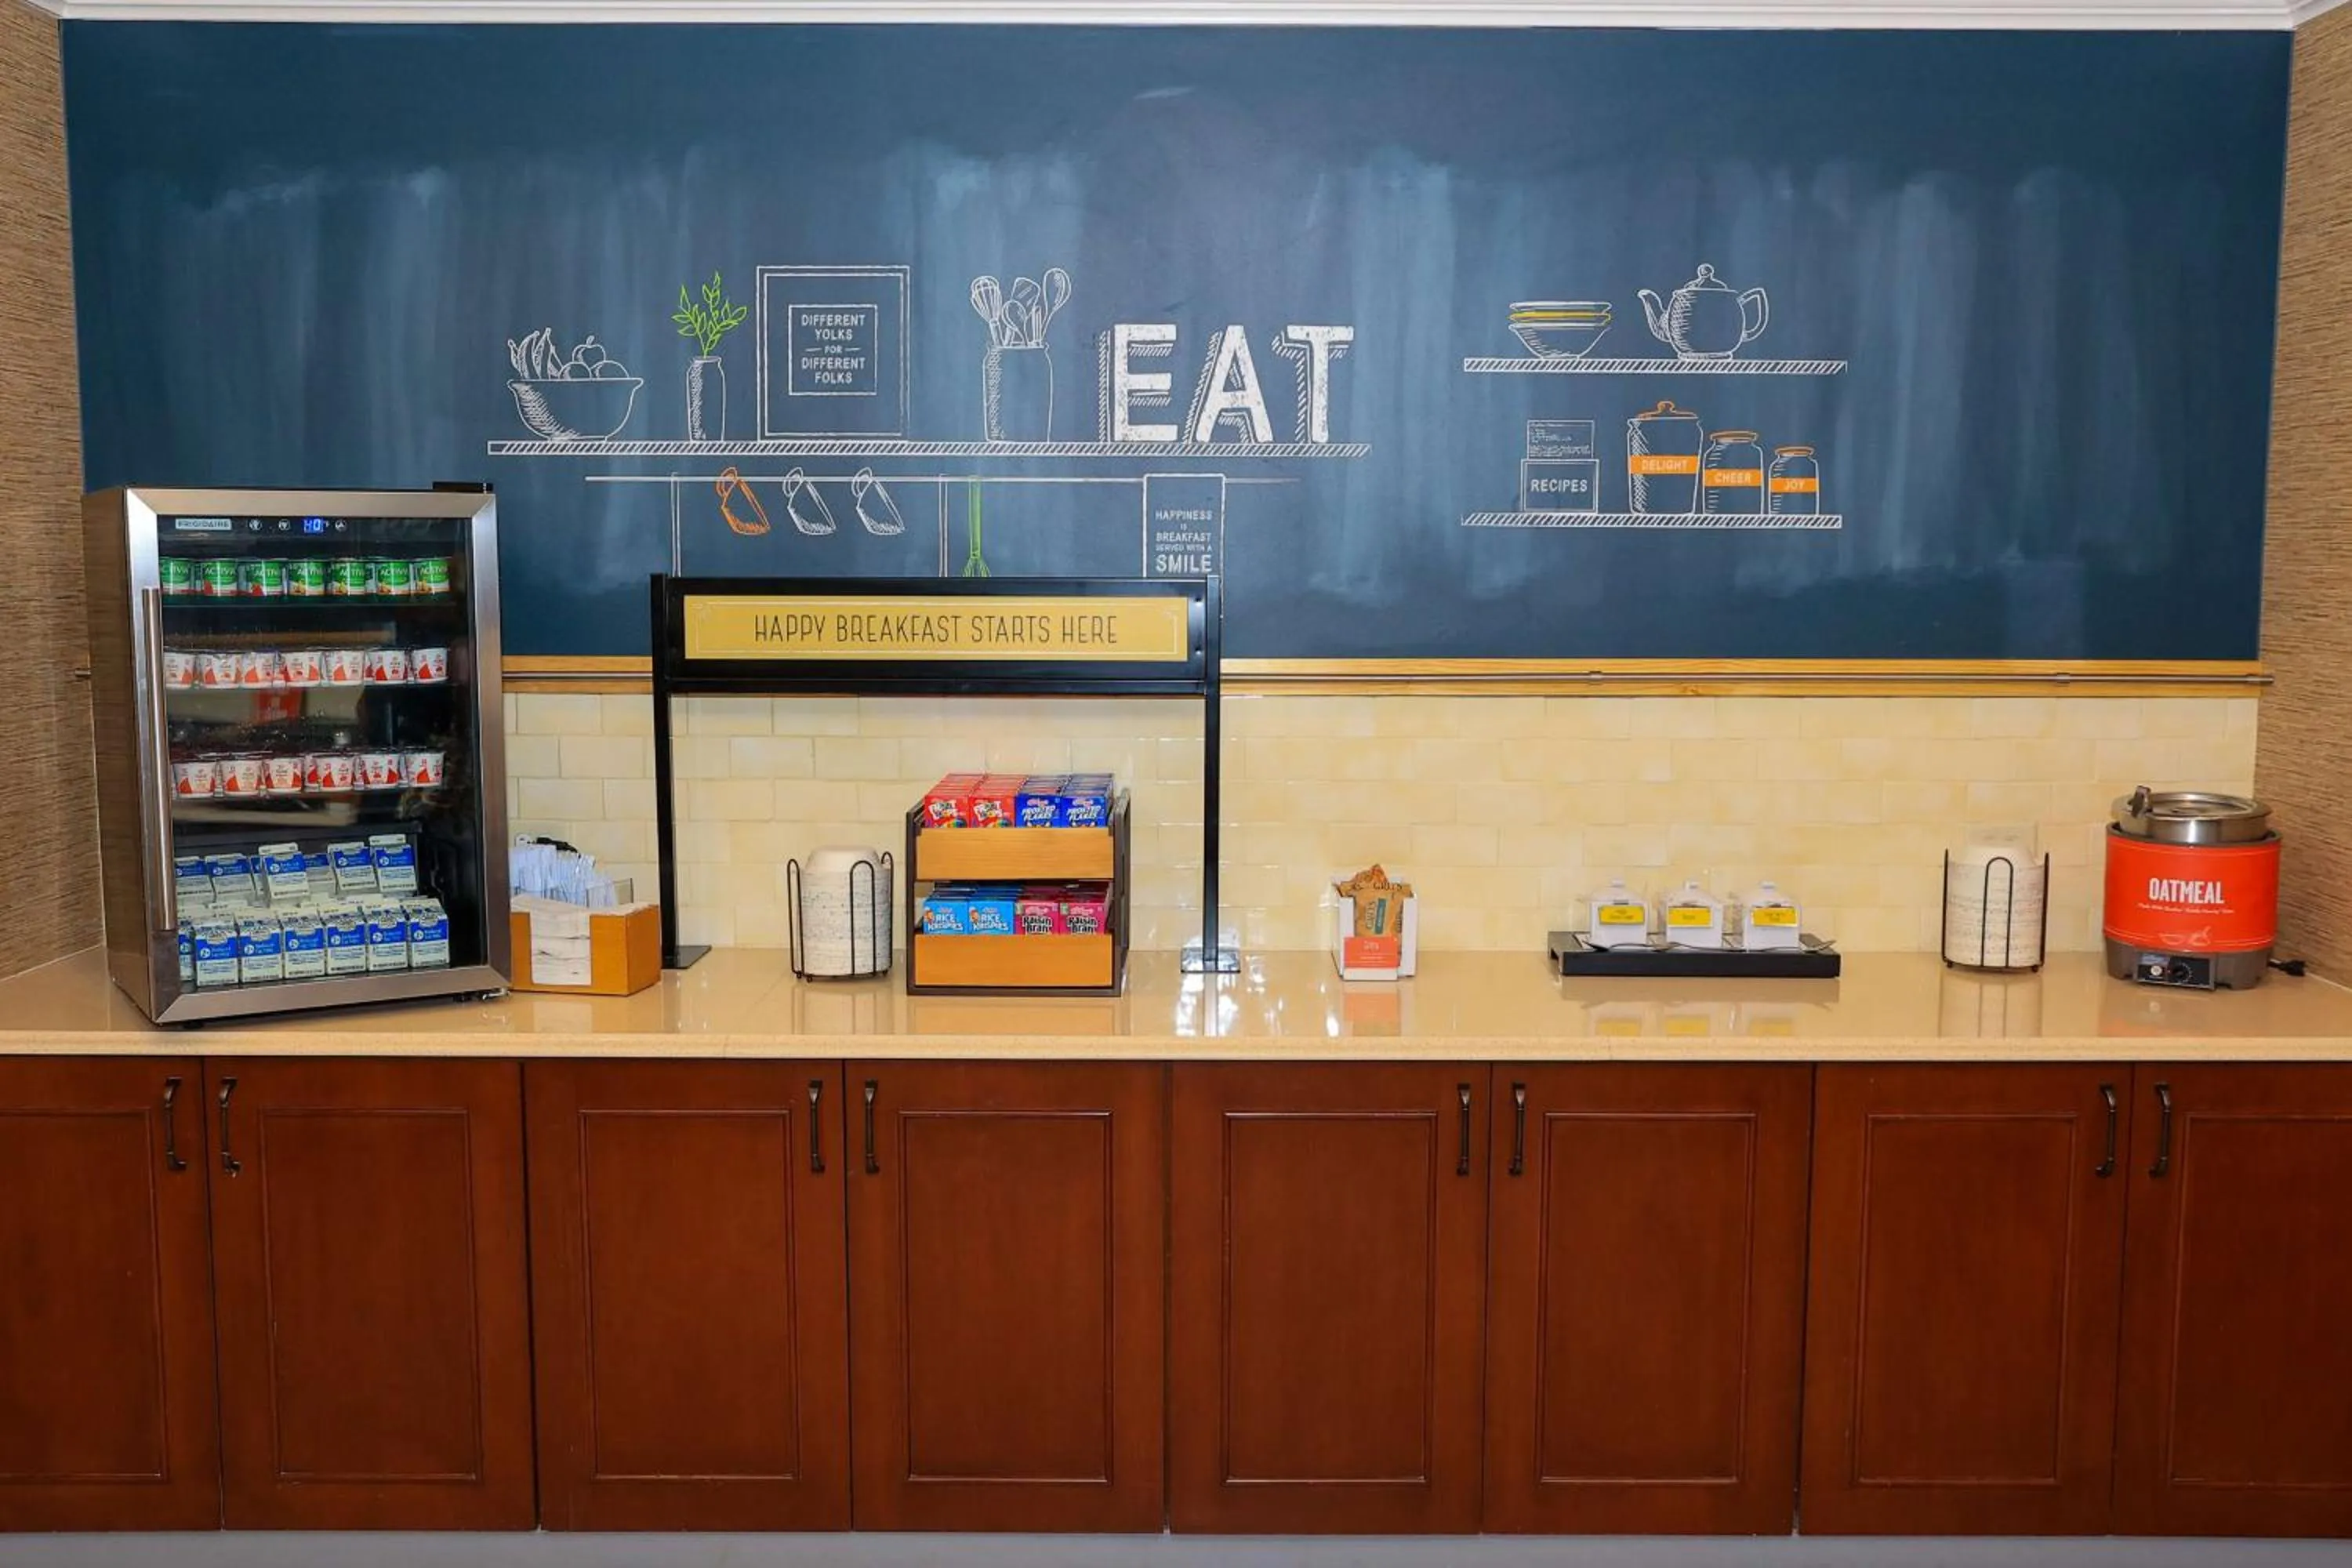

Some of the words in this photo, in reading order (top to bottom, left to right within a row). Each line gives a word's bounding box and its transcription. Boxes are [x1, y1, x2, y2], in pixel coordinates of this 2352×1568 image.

[801, 314, 866, 326] DIFFERENT
[815, 328, 853, 341] YOLKS
[824, 345, 843, 354] FOR
[801, 357, 866, 369] DIFFERENT
[815, 372, 853, 384] FOLKS
[1099, 323, 1355, 444] EAT
[1641, 459, 1687, 470] DELIGHT
[1714, 471, 1751, 483] CHEER
[1530, 479, 1588, 492] RECIPES
[1784, 481, 1806, 490] JOY
[1155, 510, 1212, 521] HAPPINESS
[1155, 532, 1211, 543] BREAKFAST
[1155, 554, 1212, 573] SMILE
[754, 614, 826, 642] HAPPY
[837, 615, 961, 643] BREAKFAST
[971, 615, 1050, 643] STARTS
[1062, 615, 1117, 643] HERE
[2148, 877, 2225, 904] OATMEAL
